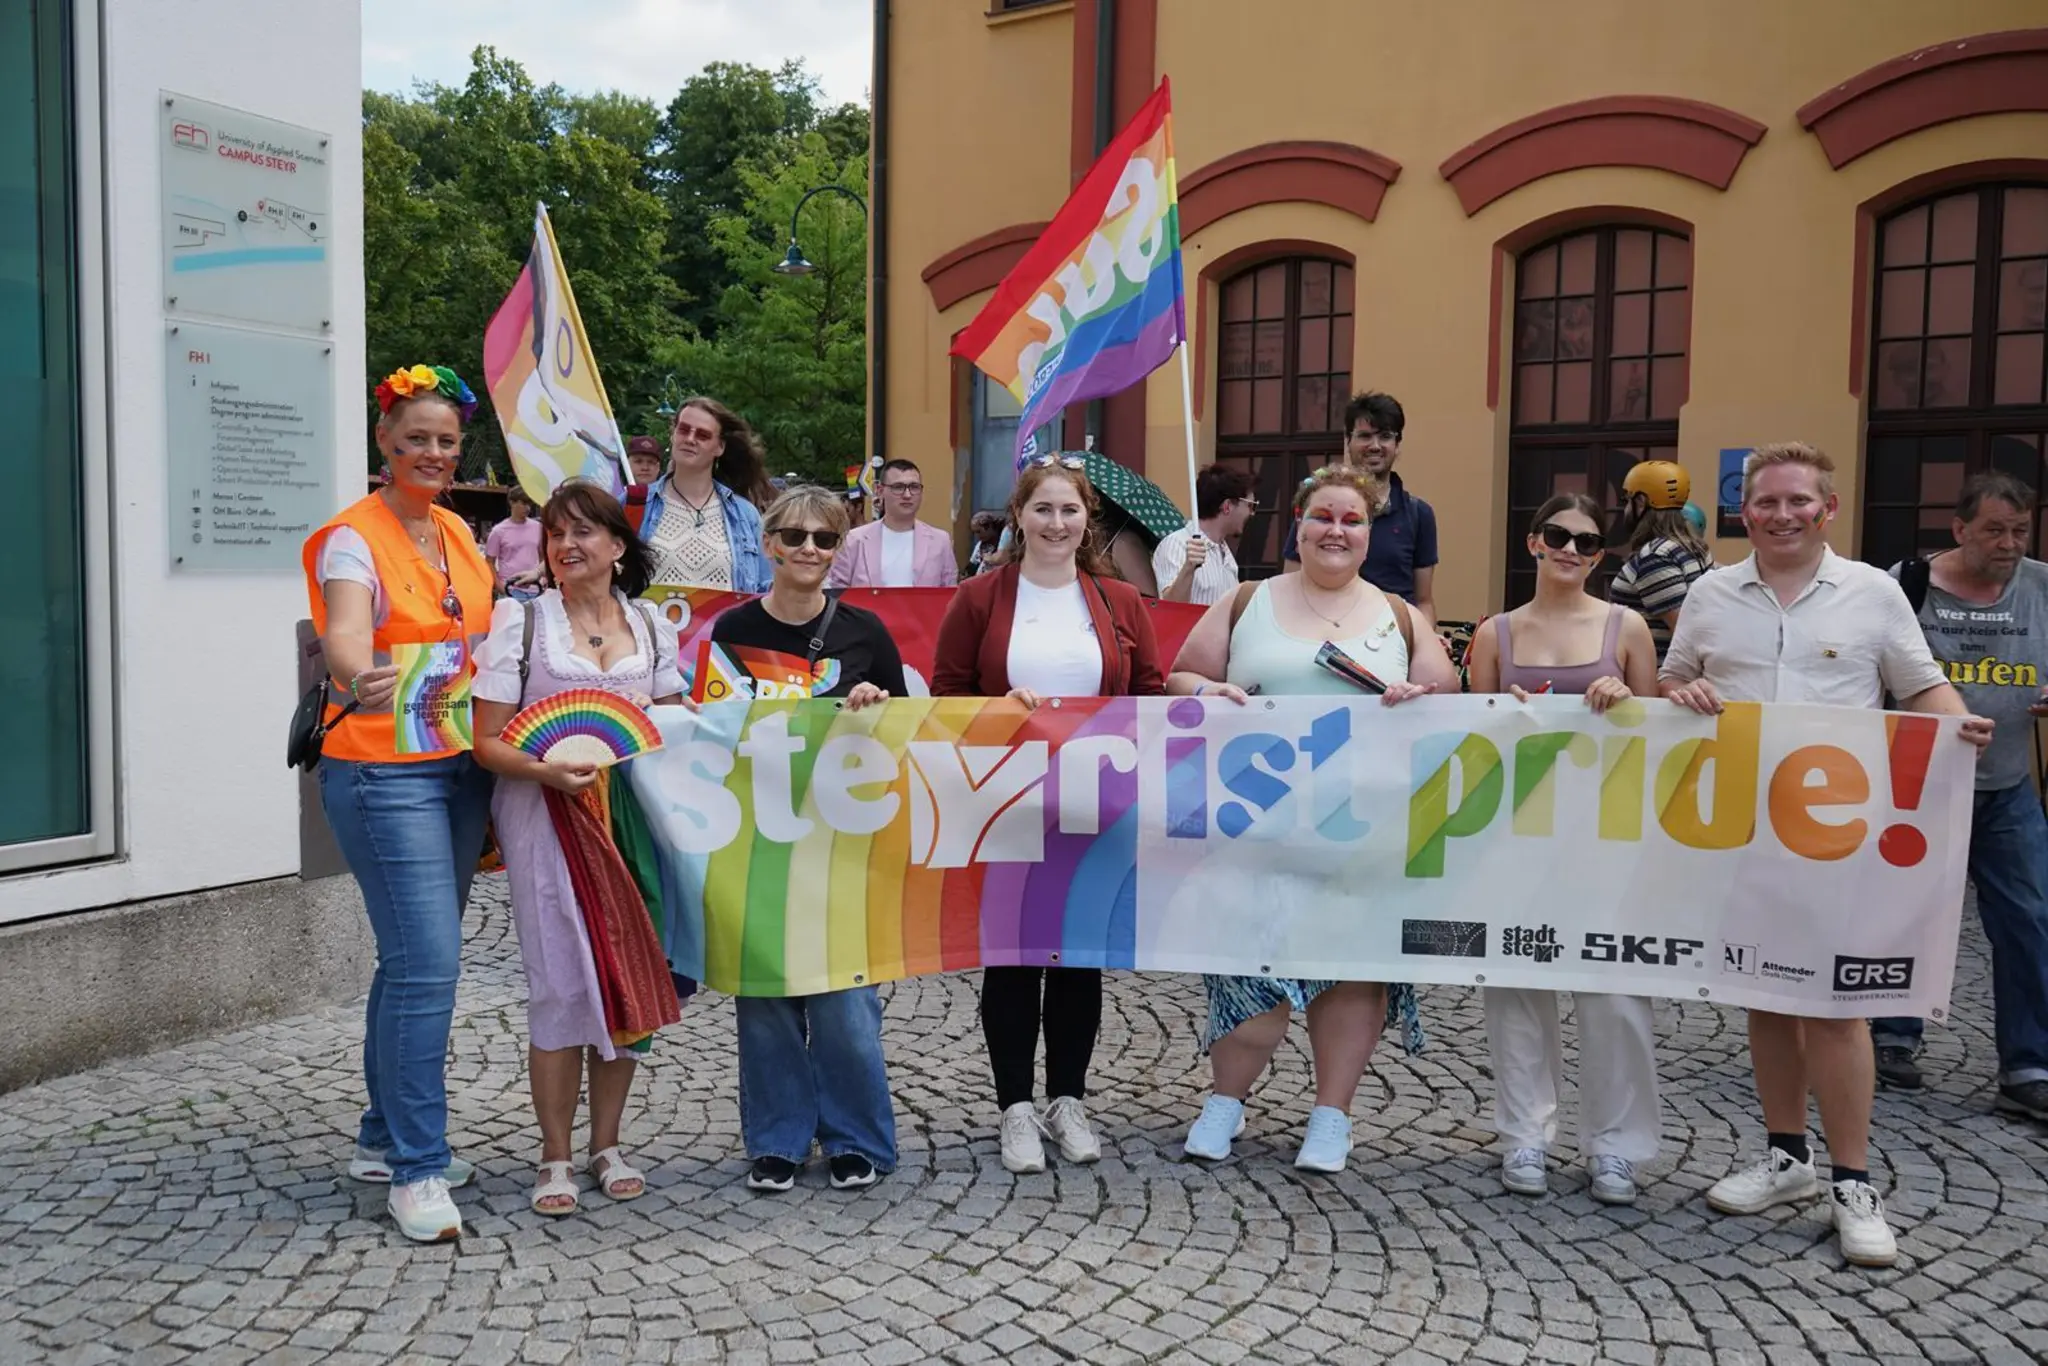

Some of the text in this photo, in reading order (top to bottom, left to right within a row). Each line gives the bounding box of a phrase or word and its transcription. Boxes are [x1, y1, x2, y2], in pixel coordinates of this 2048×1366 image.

[217, 131, 255, 149] University
[257, 141, 265, 149] of
[266, 143, 294, 157] Applied
[295, 150, 325, 165] Sciences
[217, 145, 264, 166] CAMPUS
[266, 158, 297, 173] STEYR
[188, 351, 204, 363] FH
[1935, 608, 2014, 623] Wer tanzt,
[1941, 626, 1965, 635] nur
[1968, 626, 1998, 636] kein
[2001, 626, 2029, 636] Geld
[1933, 655, 2038, 686] ufen
[425, 718, 443, 728] wir
[1165, 696, 1371, 842] ist
[1404, 697, 1940, 878] pride!
[1502, 924, 1556, 943] stadt
[1581, 932, 1704, 967] SKF
[1761, 960, 1816, 977] Atteneder
[1839, 963, 1908, 986] GRS
